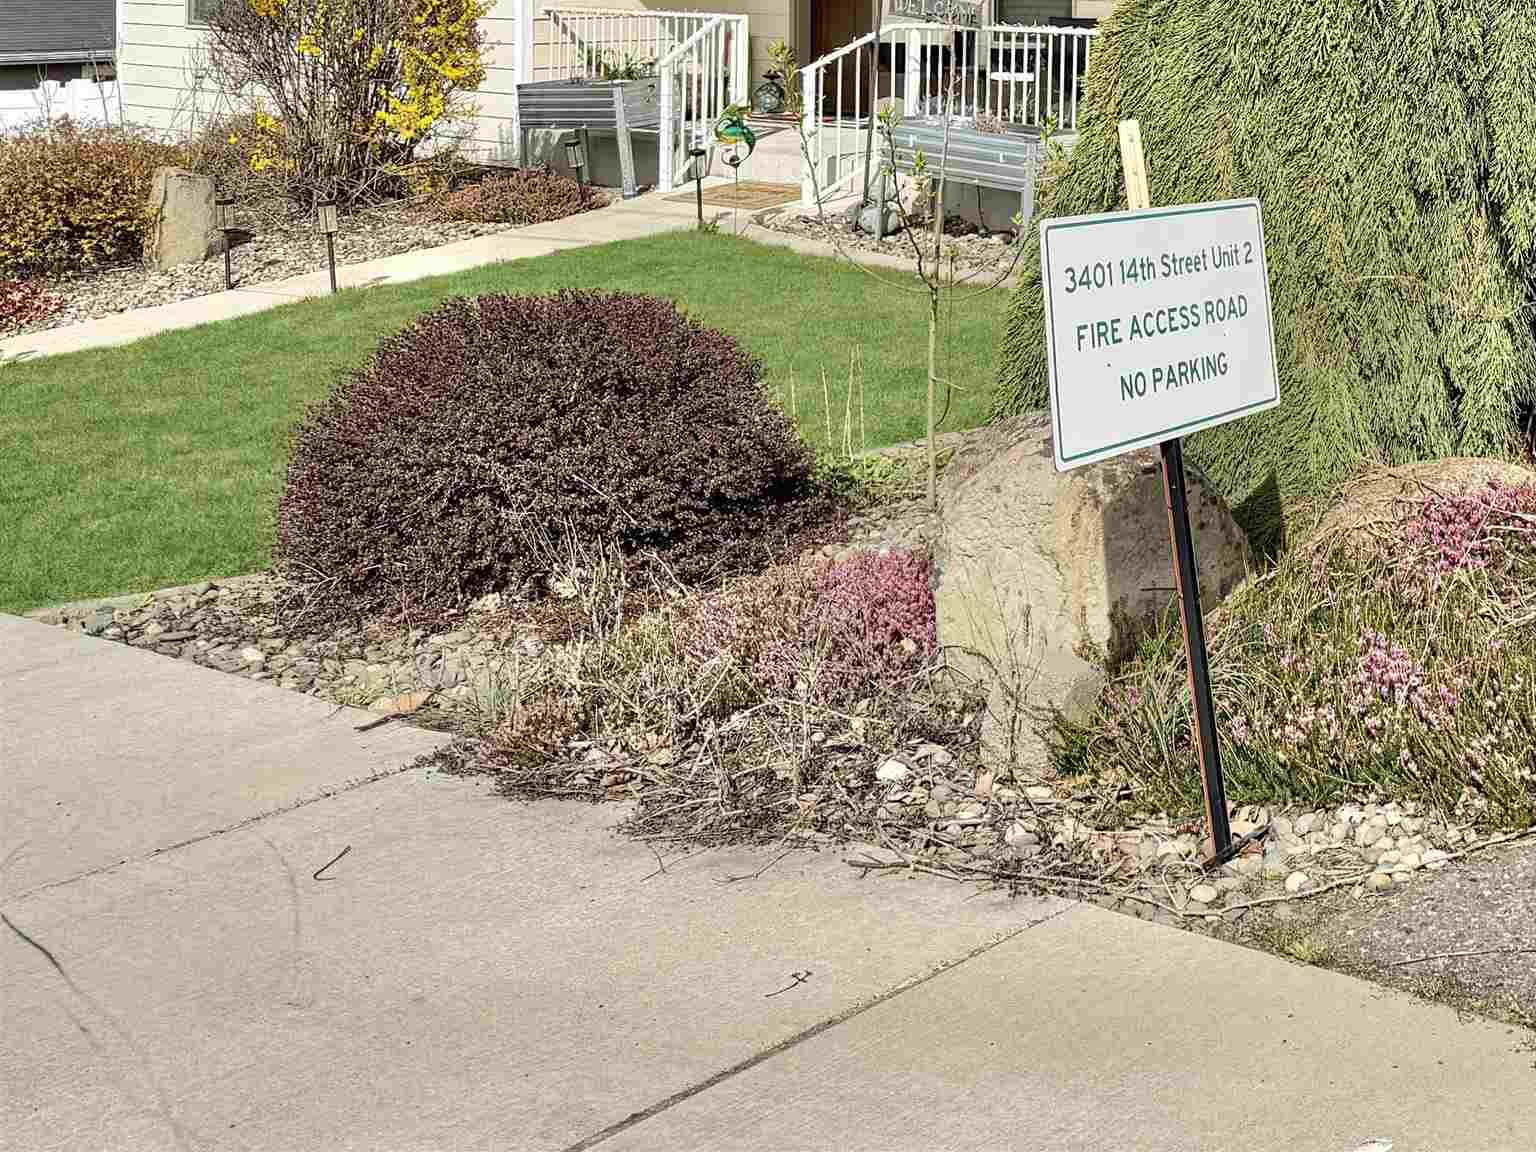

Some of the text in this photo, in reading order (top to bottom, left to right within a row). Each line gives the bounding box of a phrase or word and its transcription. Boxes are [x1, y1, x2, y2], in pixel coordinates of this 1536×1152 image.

[1064, 241, 1254, 294] 3401 14th Street Unit 2
[1076, 294, 1248, 352] FIRE ACCESS ROAD
[1120, 352, 1229, 401] NO PARKING
